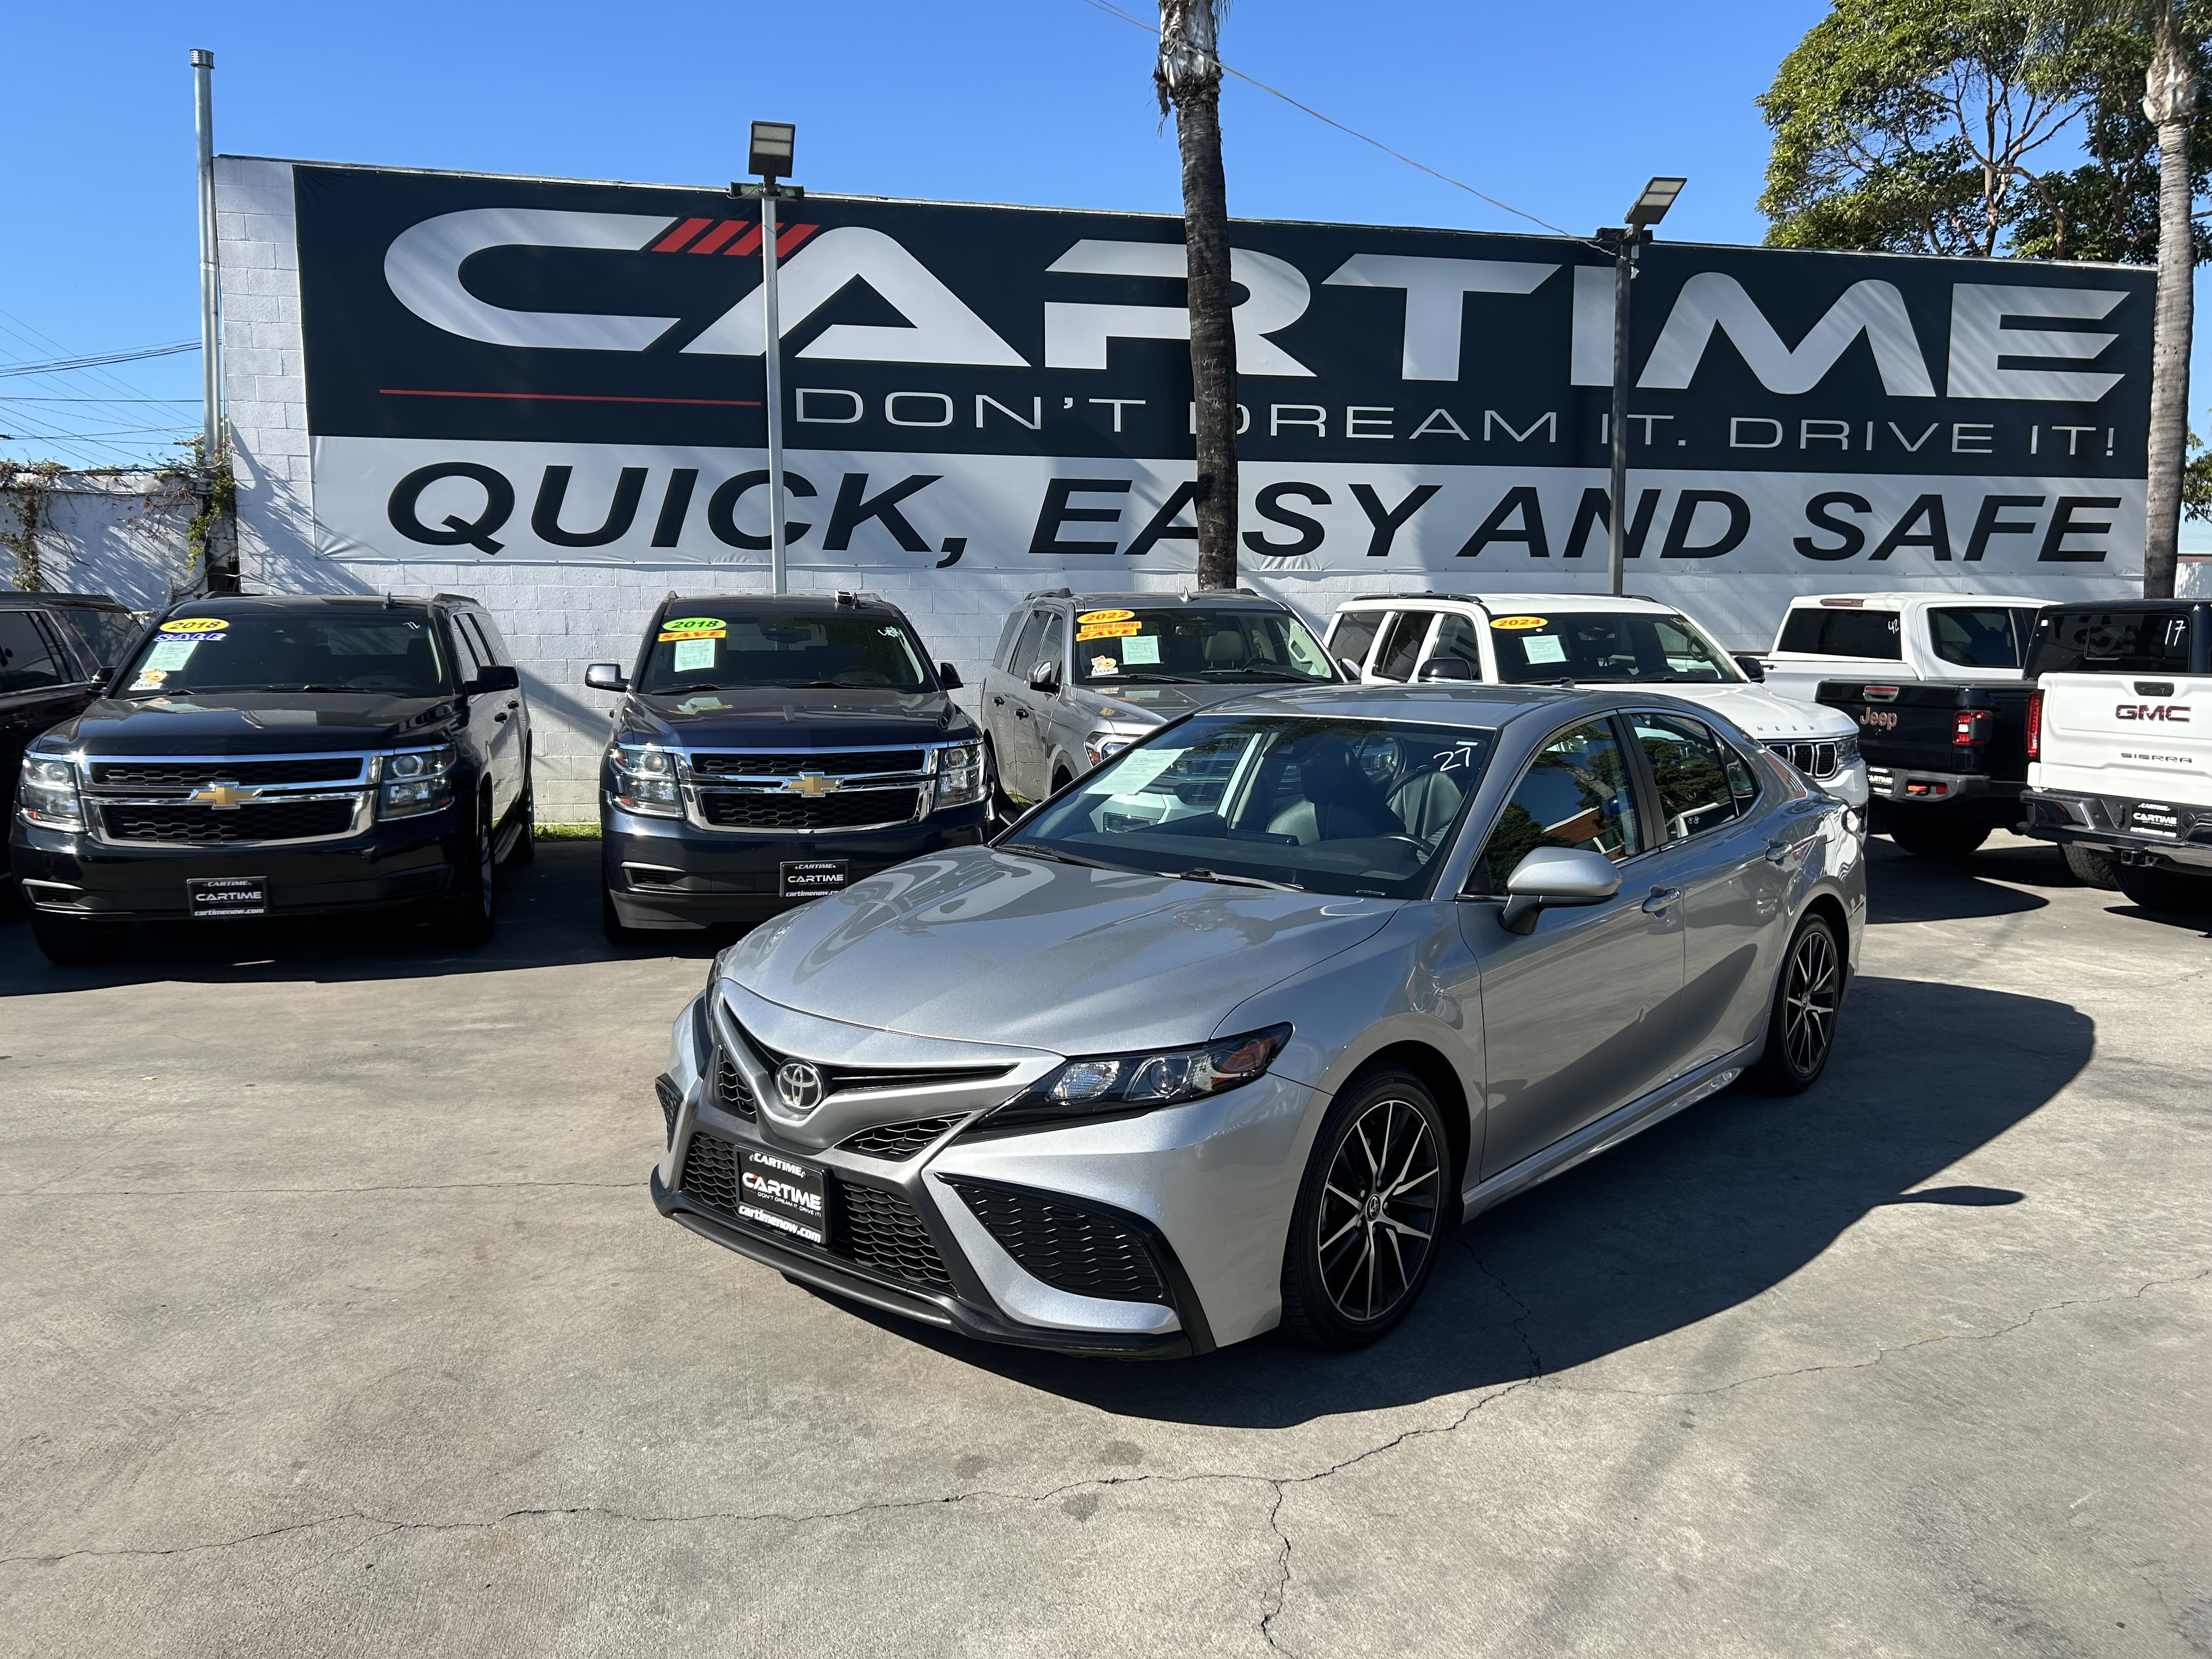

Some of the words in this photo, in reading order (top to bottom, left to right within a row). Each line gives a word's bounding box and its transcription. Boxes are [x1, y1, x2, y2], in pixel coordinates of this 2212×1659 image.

[384, 207, 2131, 402] CARTIME
[796, 387, 1146, 433] DON'T
[1601, 413, 1686, 446] IT.
[1730, 417, 1994, 454] DRIVE
[2031, 425, 2114, 456] IT!
[387, 461, 967, 568] QUICK,
[1455, 486, 1750, 558] AND
[1793, 492, 2121, 563] SAFE
[167, 621, 222, 629] 2018
[1085, 612, 1129, 622] 2022
[661, 631, 724, 639] SAVE
[1078, 630, 1134, 639] SAVE
[1888, 619, 1899, 634] 42
[2165, 620, 2186, 646] 17
[154, 633, 227, 642] SALE
[1860, 707, 1897, 730] Jeep
[2115, 704, 2192, 723] GMC
[1433, 747, 1471, 771] 27
[2121, 753, 2192, 763] SIERRA
[2133, 812, 2177, 824] CARTIME
[788, 874, 844, 883] CARTIME
[196, 891, 262, 901] CARTIME
[754, 1153, 802, 1176] CARTIME
[742, 1172, 822, 1211] CARTIME
[739, 1205, 821, 1244] cartimenow.com
